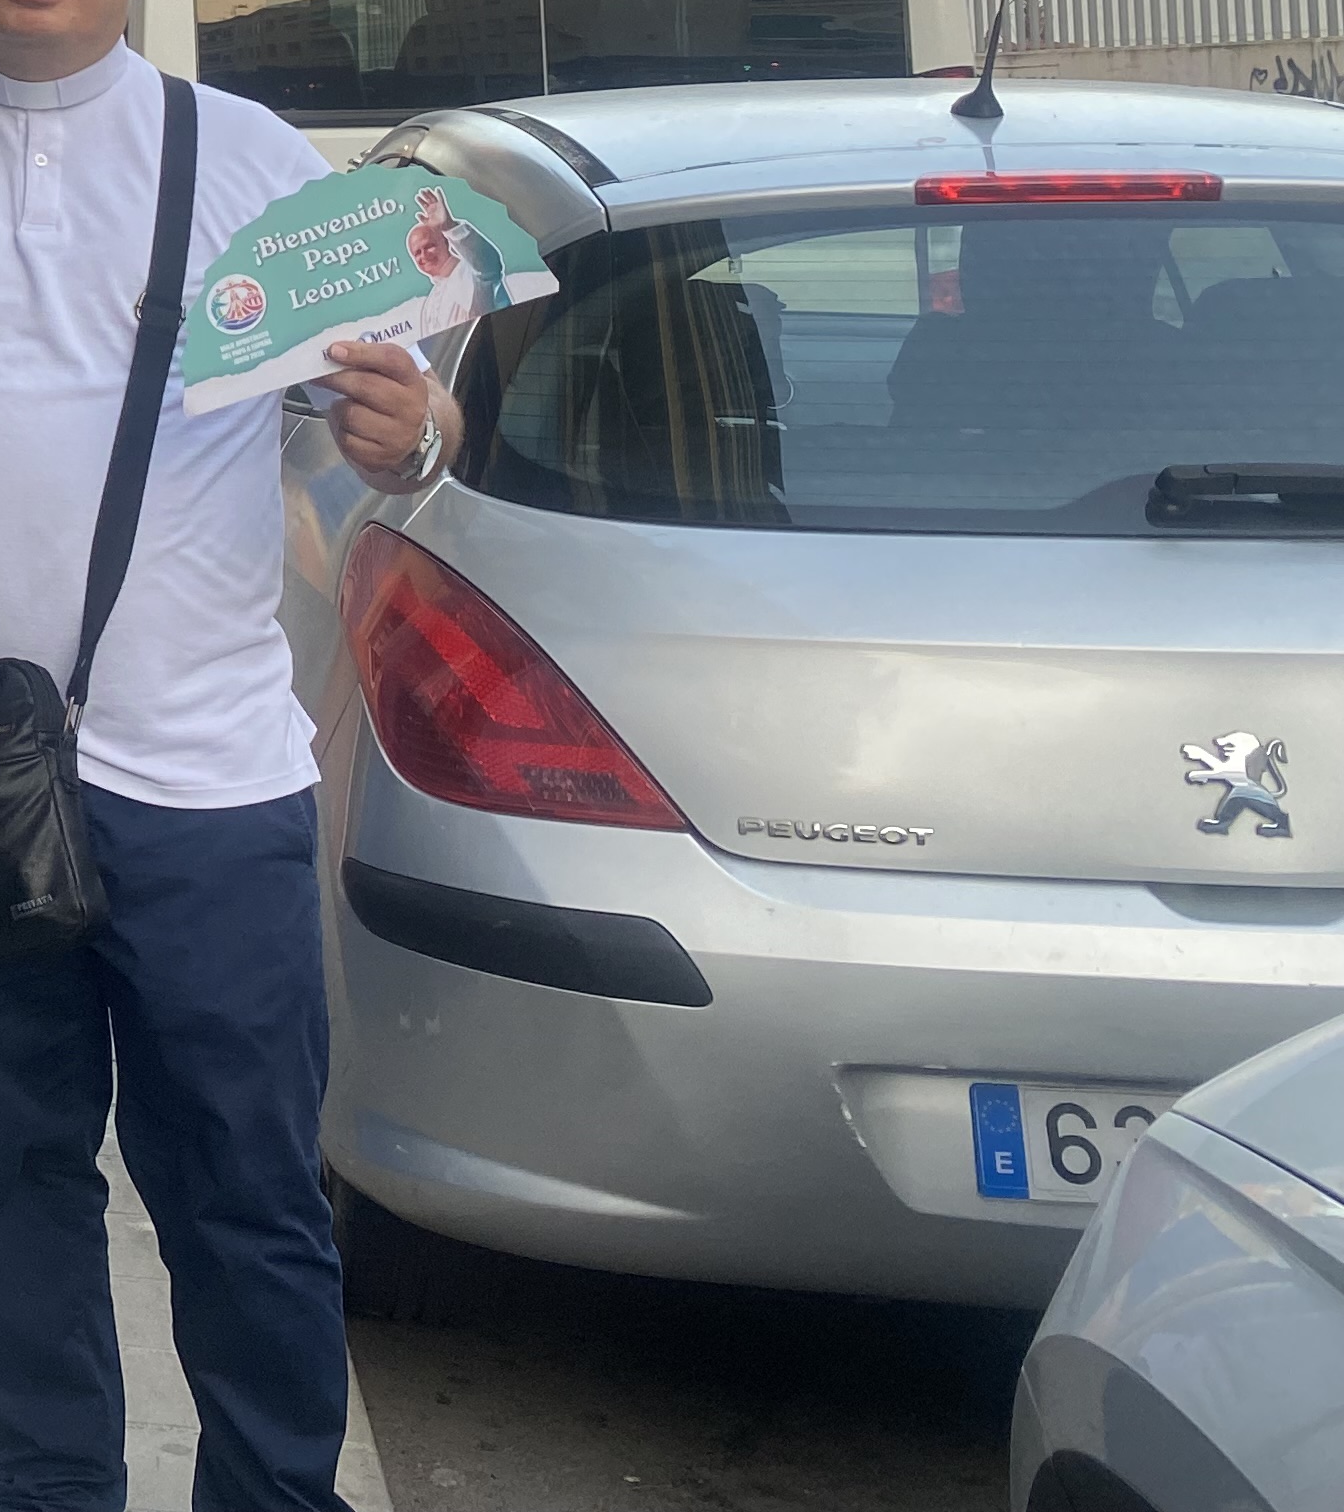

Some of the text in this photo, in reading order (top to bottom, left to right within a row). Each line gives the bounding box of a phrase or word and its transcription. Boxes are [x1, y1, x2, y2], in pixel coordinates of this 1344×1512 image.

[252, 197, 405, 266] ¡Bienvenido,
[302, 238, 369, 271] Papa
[288, 256, 401, 309] León XIV!
[370, 320, 413, 343] MARIA
[737, 816, 934, 846] PEUGEOT
[994, 1151, 1015, 1174] E
